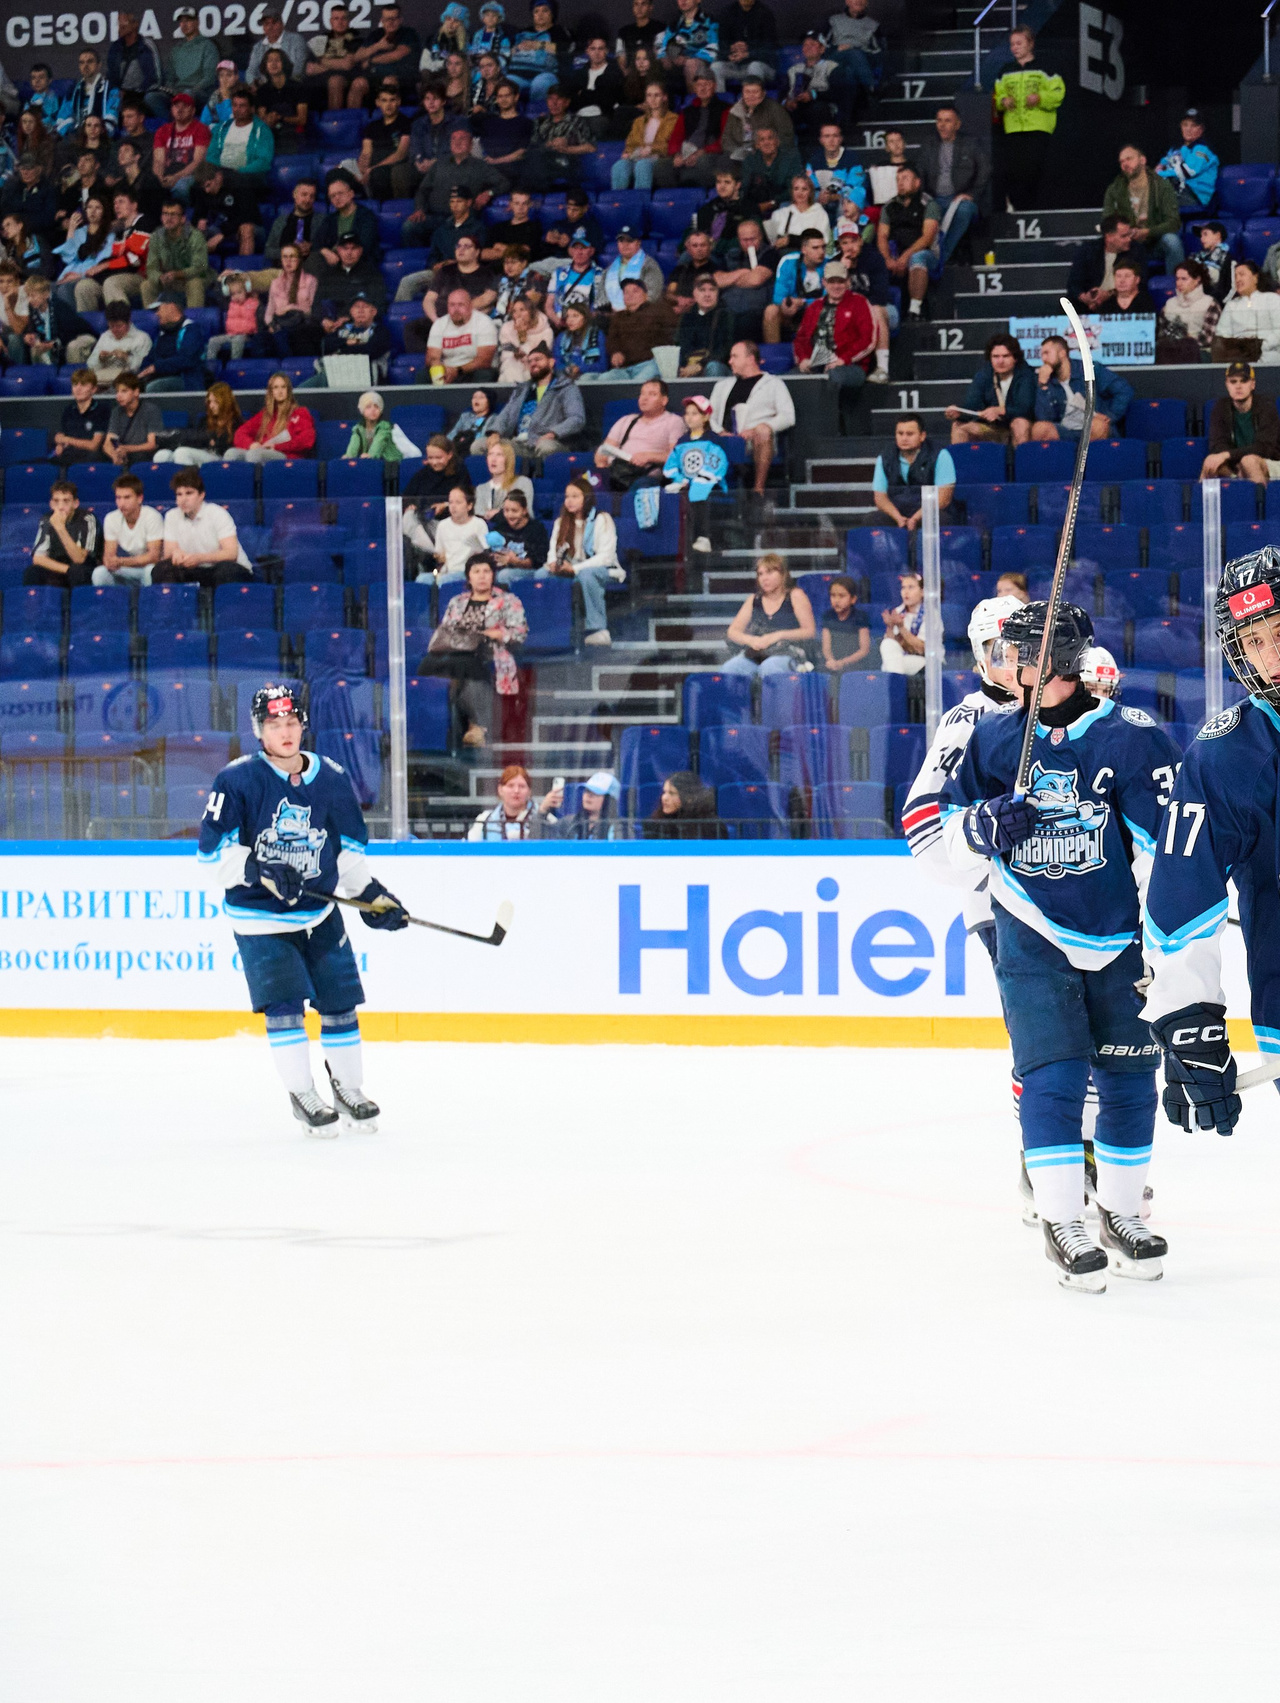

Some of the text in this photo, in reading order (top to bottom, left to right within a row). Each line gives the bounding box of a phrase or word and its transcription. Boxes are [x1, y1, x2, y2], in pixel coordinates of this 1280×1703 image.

[1079, 2, 1125, 101] E3
[902, 80, 926, 99] 17
[863, 130, 886, 148] 16
[1016, 219, 1041, 240] 14
[976, 273, 1003, 294] 13
[938, 328, 964, 350] 12
[898, 390, 919, 410] 11
[1237, 569, 1254, 588] 17
[1235, 598, 1271, 617] OLIMPBET
[1152, 761, 1183, 806] 3
[202, 791, 225, 821] 4
[1034, 826, 1081, 837] ИБИРСКИЕ
[1163, 800, 1206, 857] 17
[618, 876, 967, 997] Haier
